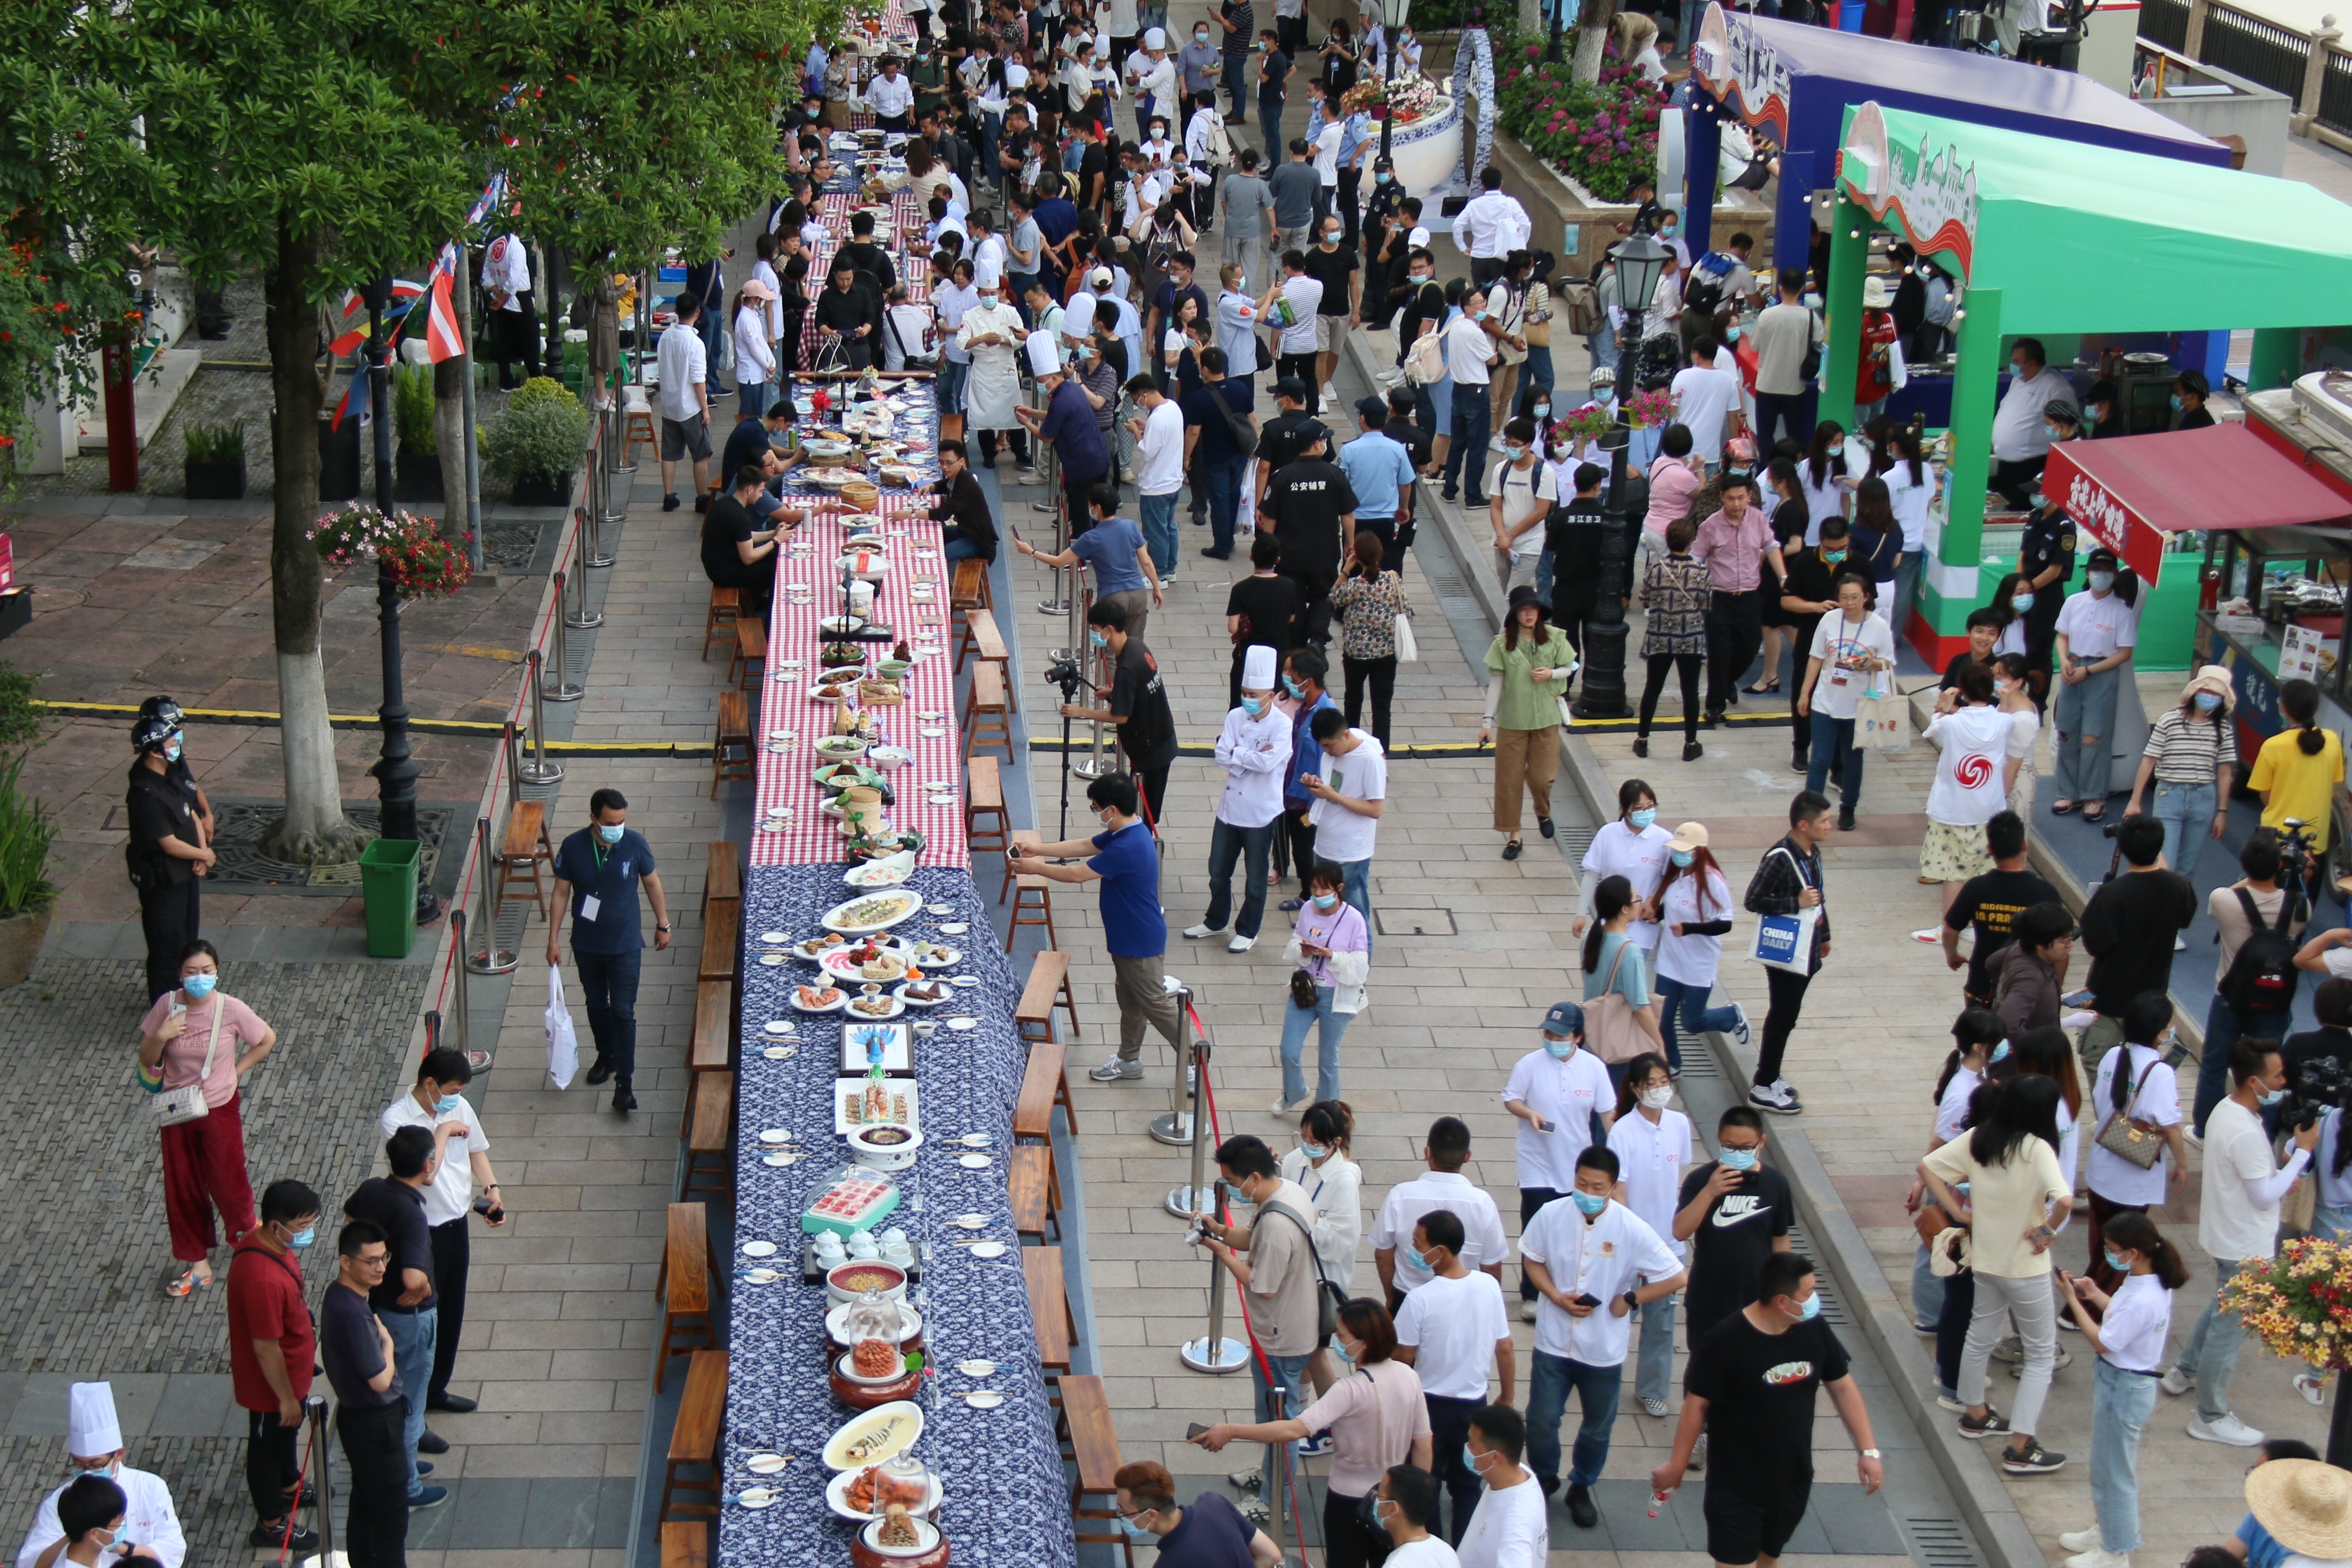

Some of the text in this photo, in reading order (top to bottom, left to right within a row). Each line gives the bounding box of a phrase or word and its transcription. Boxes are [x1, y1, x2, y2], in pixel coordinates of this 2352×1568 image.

[1290, 480, 1327, 491] 公安辅警
[1567, 514, 1601, 524] 浙江京卫
[1988, 912, 2012, 923] PRA
[1762, 926, 1794, 941] CHINA
[1761, 936, 1792, 950] DAILY
[1720, 1195, 1760, 1213] NIKE
